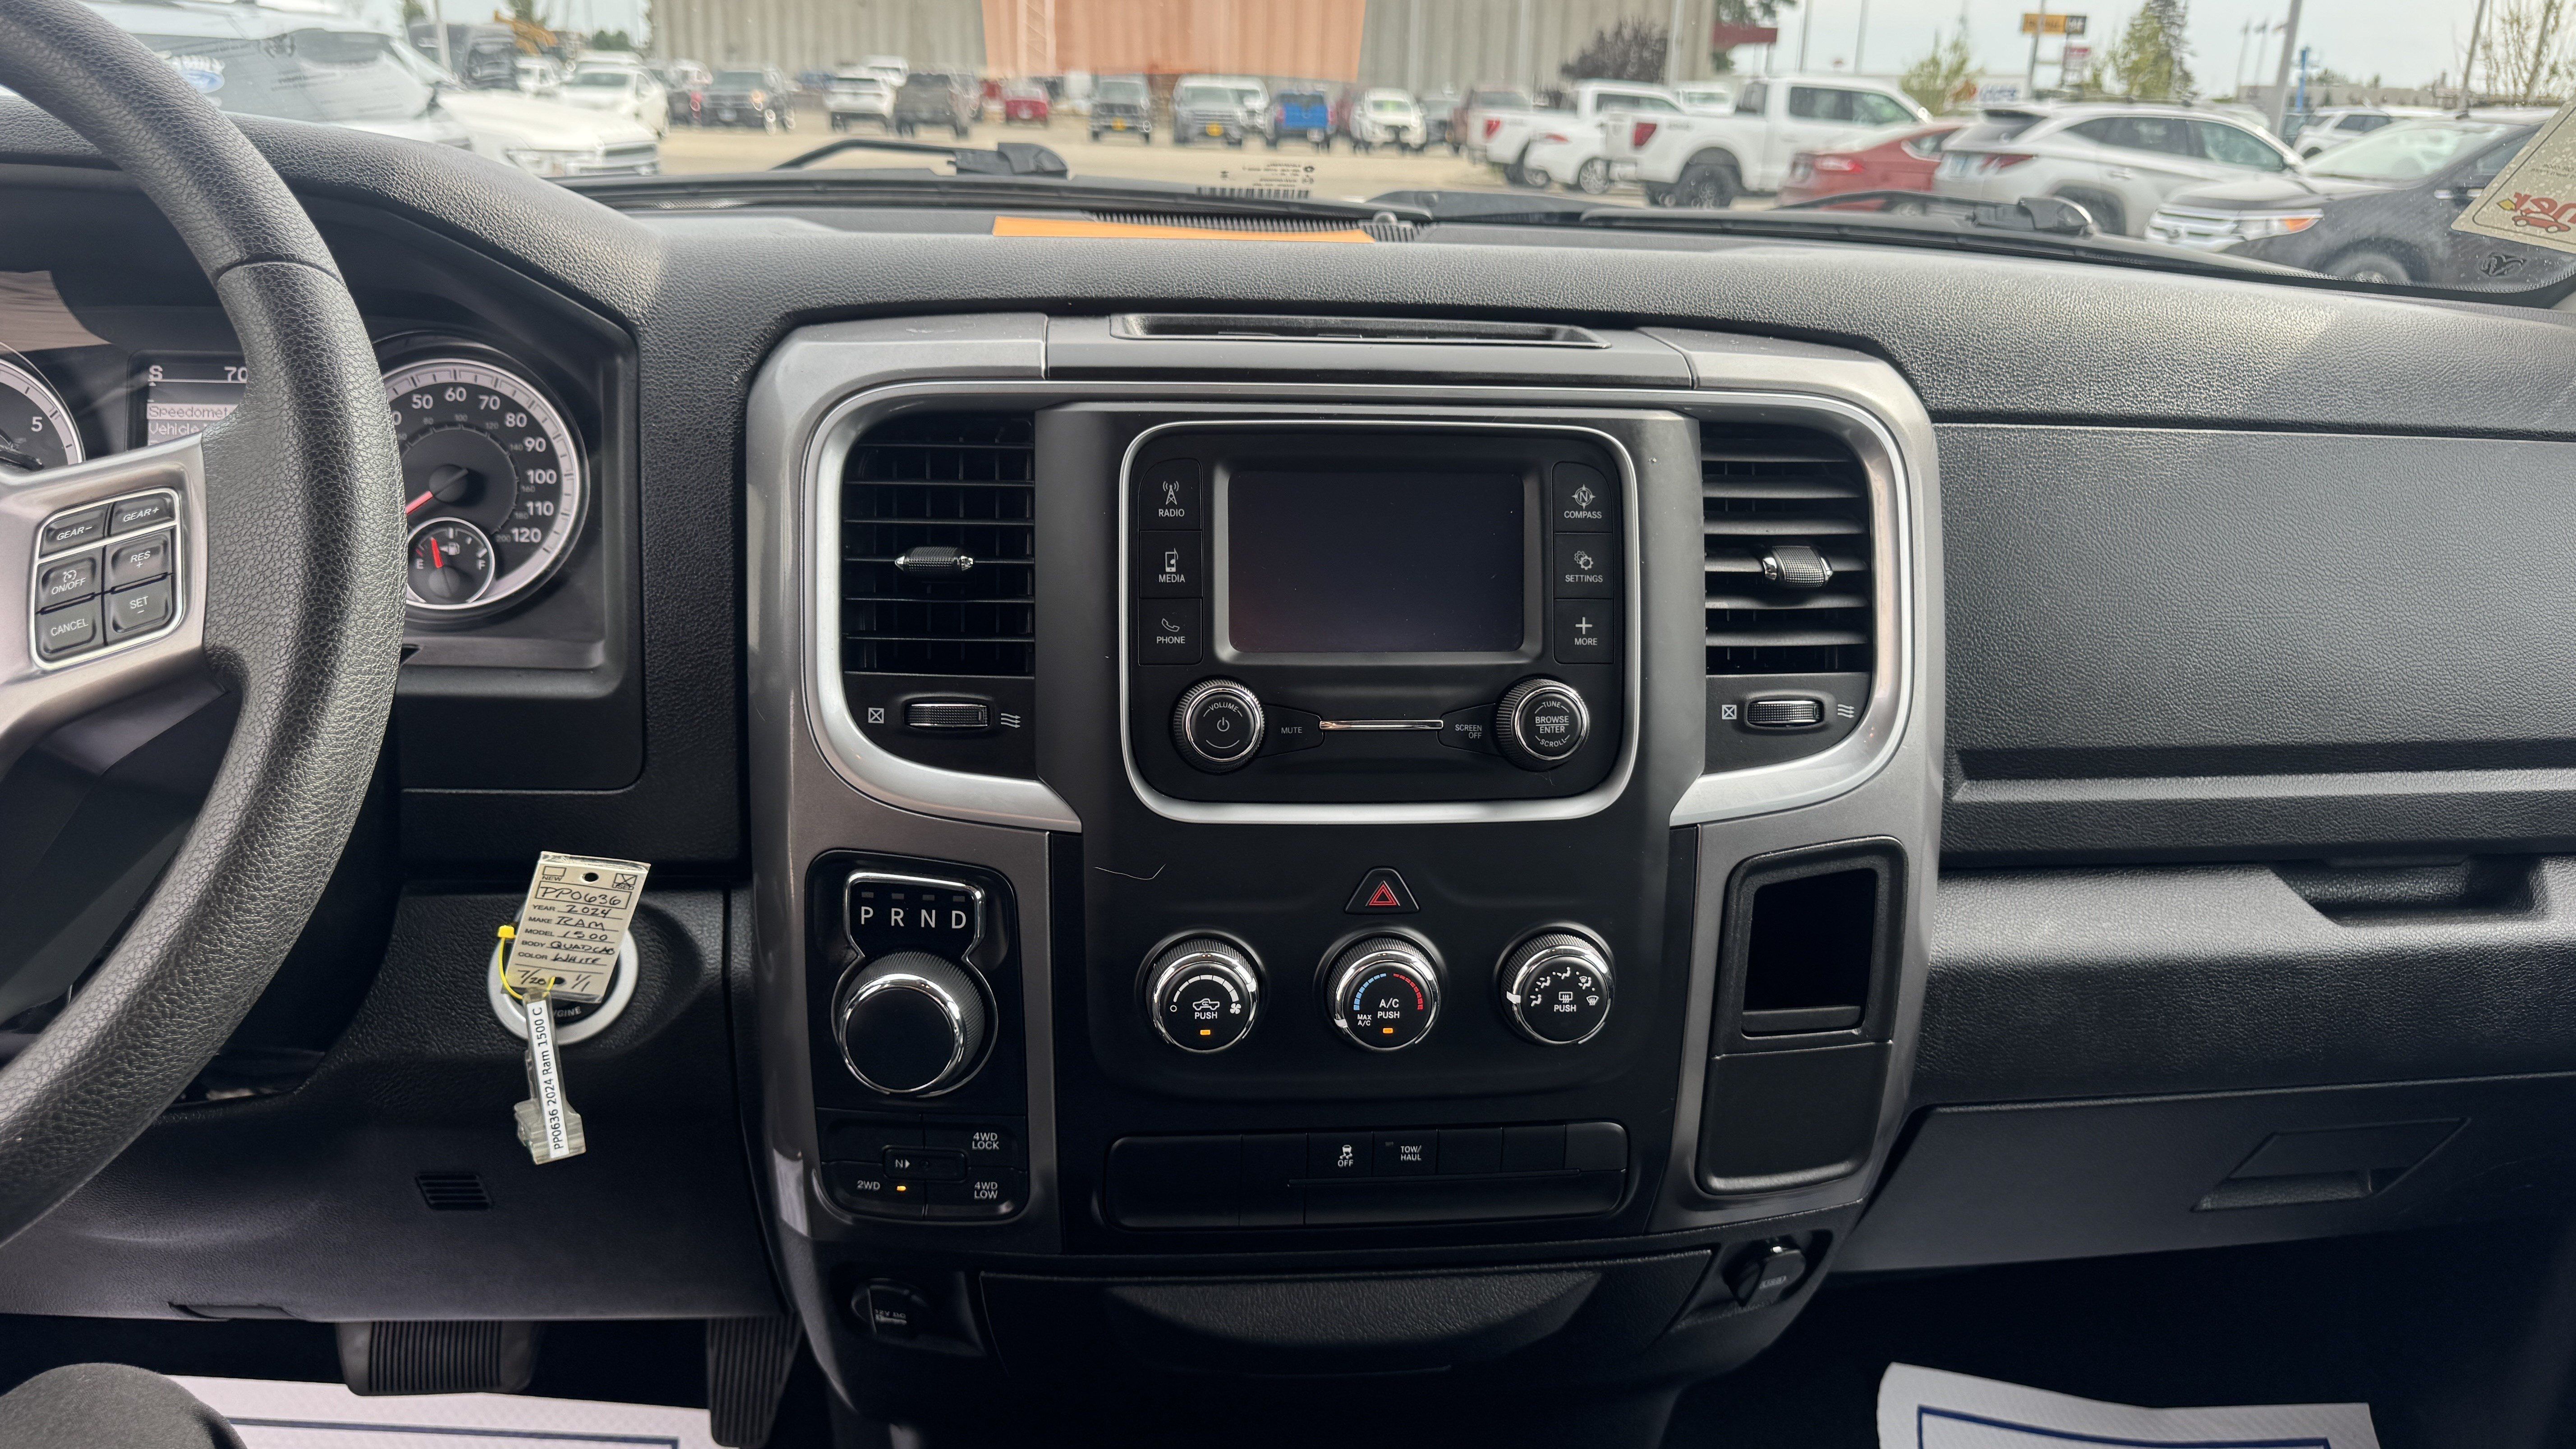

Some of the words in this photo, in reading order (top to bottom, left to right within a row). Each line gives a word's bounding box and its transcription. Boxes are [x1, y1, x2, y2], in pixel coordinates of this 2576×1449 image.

[149, 365, 163, 381] S
[445, 386, 467, 402] 60
[411, 394, 433, 409] 50
[478, 395, 501, 410] 70
[31, 416, 43, 432] 5
[505, 412, 527, 428] 80
[523, 437, 547, 452] 90
[526, 469, 557, 484] 100
[525, 501, 554, 516] 110
[1158, 508, 1185, 517] RADIO
[1564, 511, 1602, 519] COMPASS
[510, 527, 542, 543] 120
[131, 551, 151, 563] RES
[416, 558, 424, 570] E
[477, 559, 486, 570] F
[1158, 574, 1186, 583] MEDIA
[1565, 575, 1603, 583] SETTINGS
[51, 577, 86, 595] ON/OFF
[129, 596, 149, 609] SET
[51, 618, 89, 636] CANCEL
[1574, 638, 1598, 646] MORE
[1209, 702, 1239, 713] VOLUME
[1535, 716, 1569, 724] BROWSE
[1540, 726, 1565, 734] ENTER
[1540, 738, 1567, 747] SCROLL
[533, 904, 556, 912] YEAR
[566, 905, 612, 919] 2024
[861, 906, 874, 925] P
[891, 908, 904, 926] R
[921, 909, 935, 928] N
[952, 910, 966, 929] D
[529, 916, 553, 925] MAKE
[555, 916, 605, 931] RAM
[525, 929, 553, 937] MODEL
[563, 931, 608, 942] 1500
[518, 952, 548, 960] COLOR
[1379, 998, 1399, 1008] A/C
[533, 1007, 543, 1016] C
[554, 1006, 581, 1018] GINE
[534, 1019, 548, 1047] 1500
[542, 1050, 552, 1075] Ram
[544, 1078, 557, 1106] 2024
[973, 1132, 998, 1141] 4WD
[972, 1141, 999, 1150] LOCK
[1400, 1145, 1422, 1153] TOW/
[895, 1159, 903, 1168] N
[857, 1180, 880, 1191] 2WD
[974, 1182, 998, 1190] 4WD
[974, 1190, 998, 1200] LOW
